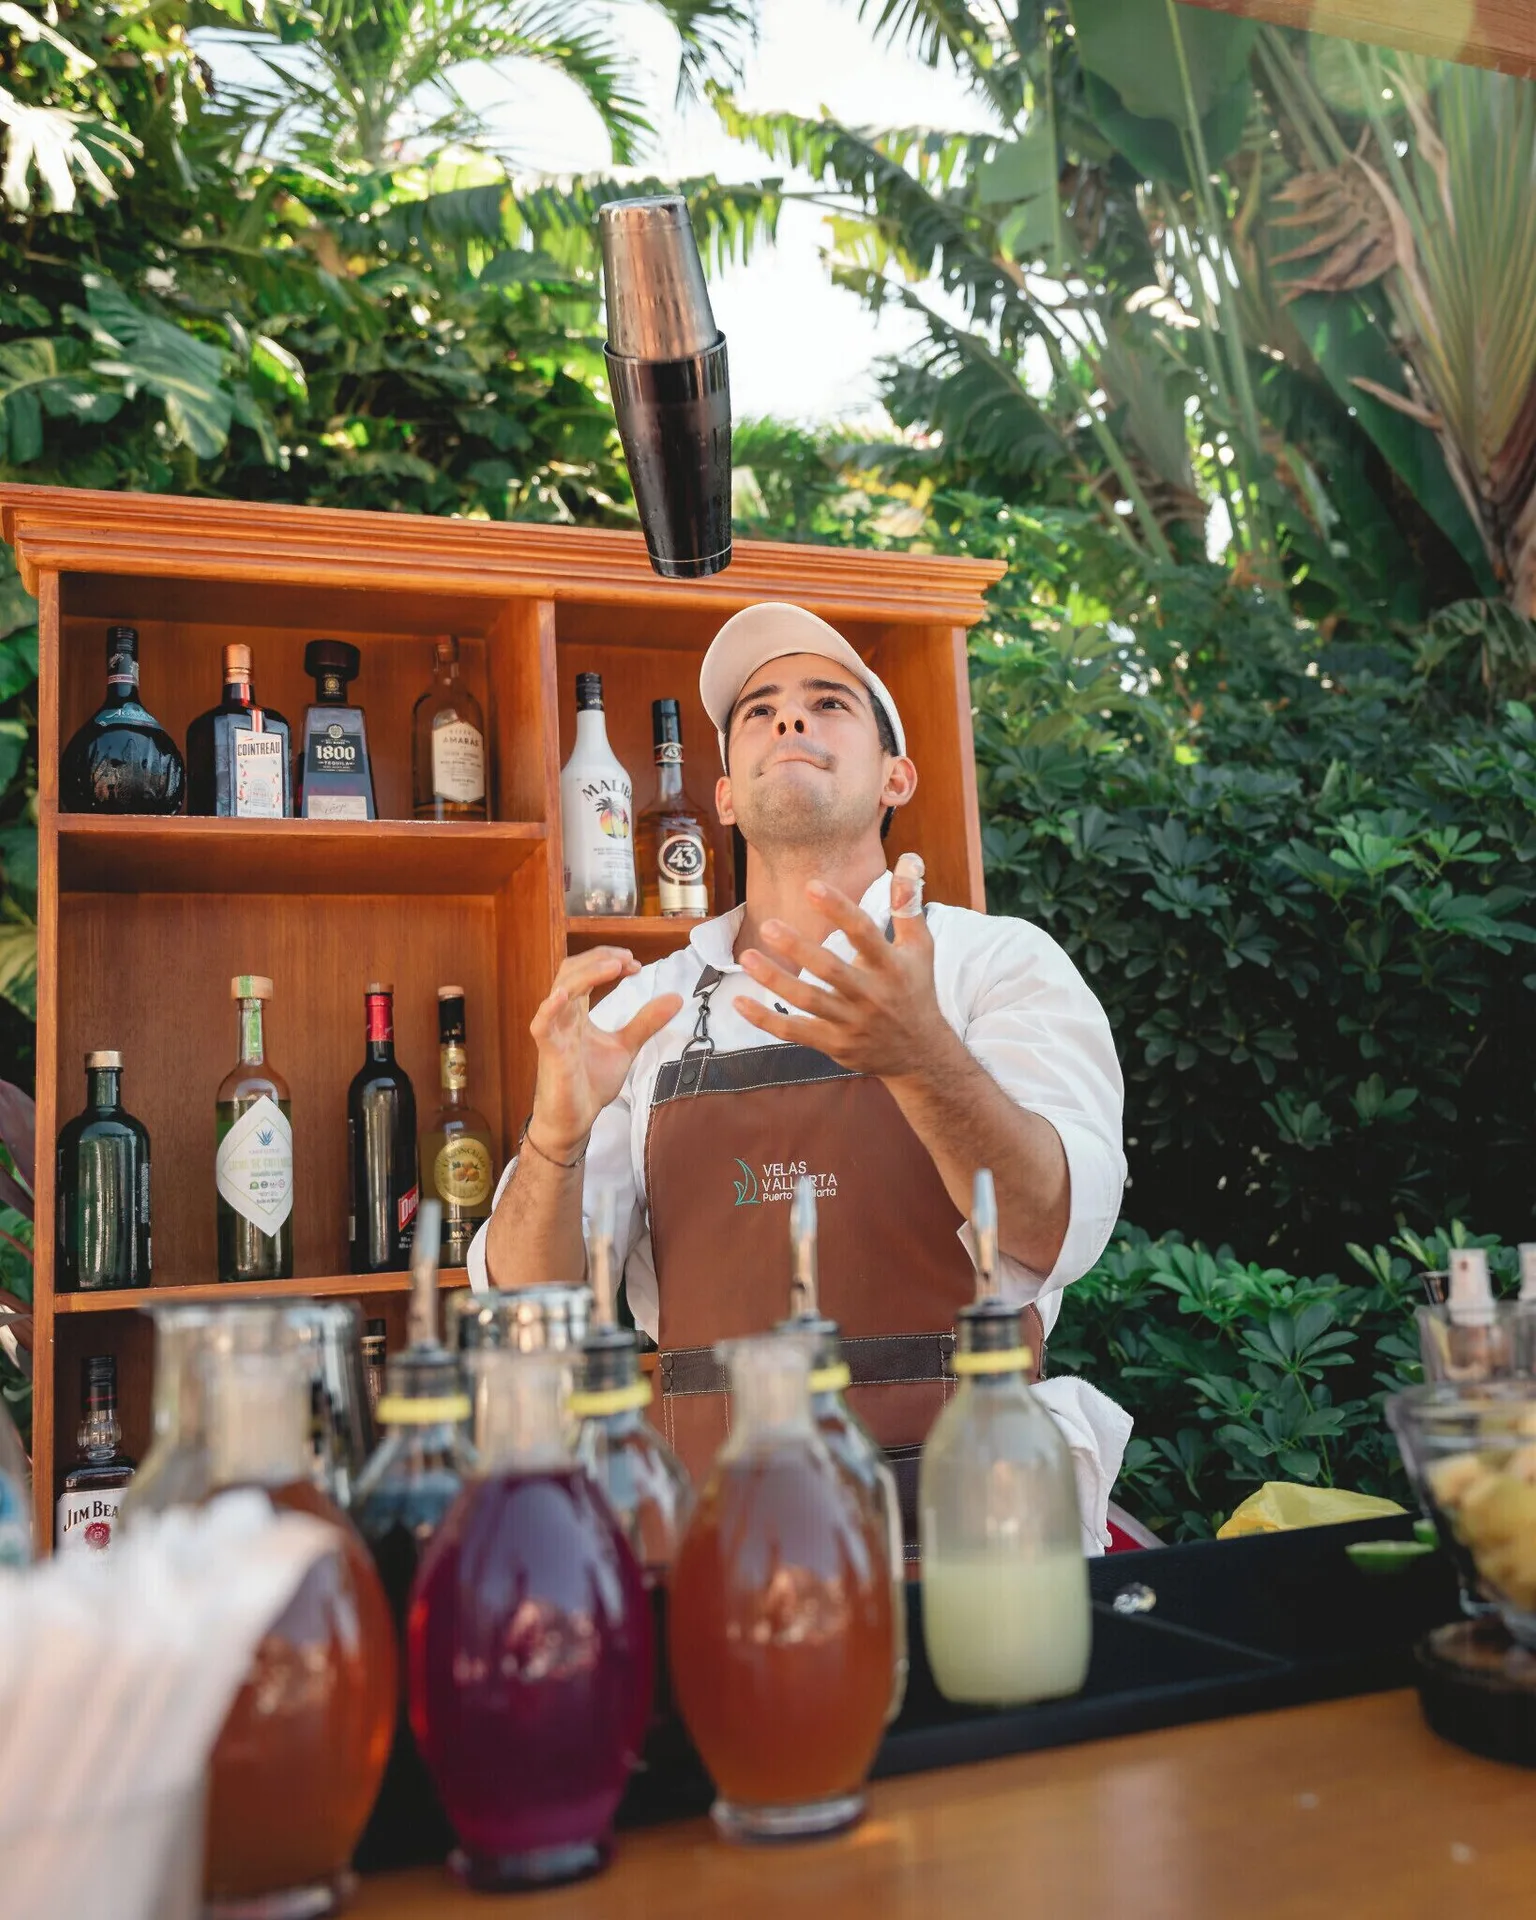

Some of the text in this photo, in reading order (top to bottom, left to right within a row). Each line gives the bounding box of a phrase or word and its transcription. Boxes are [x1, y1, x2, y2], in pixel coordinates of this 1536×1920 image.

[237, 741, 281, 757] COINTREAU
[315, 745, 356, 761] 1800
[667, 846, 698, 868] 43
[762, 1161, 807, 1177] VELAS
[762, 1191, 793, 1202] Puerto
[63, 1500, 119, 1532] JIM BEA
